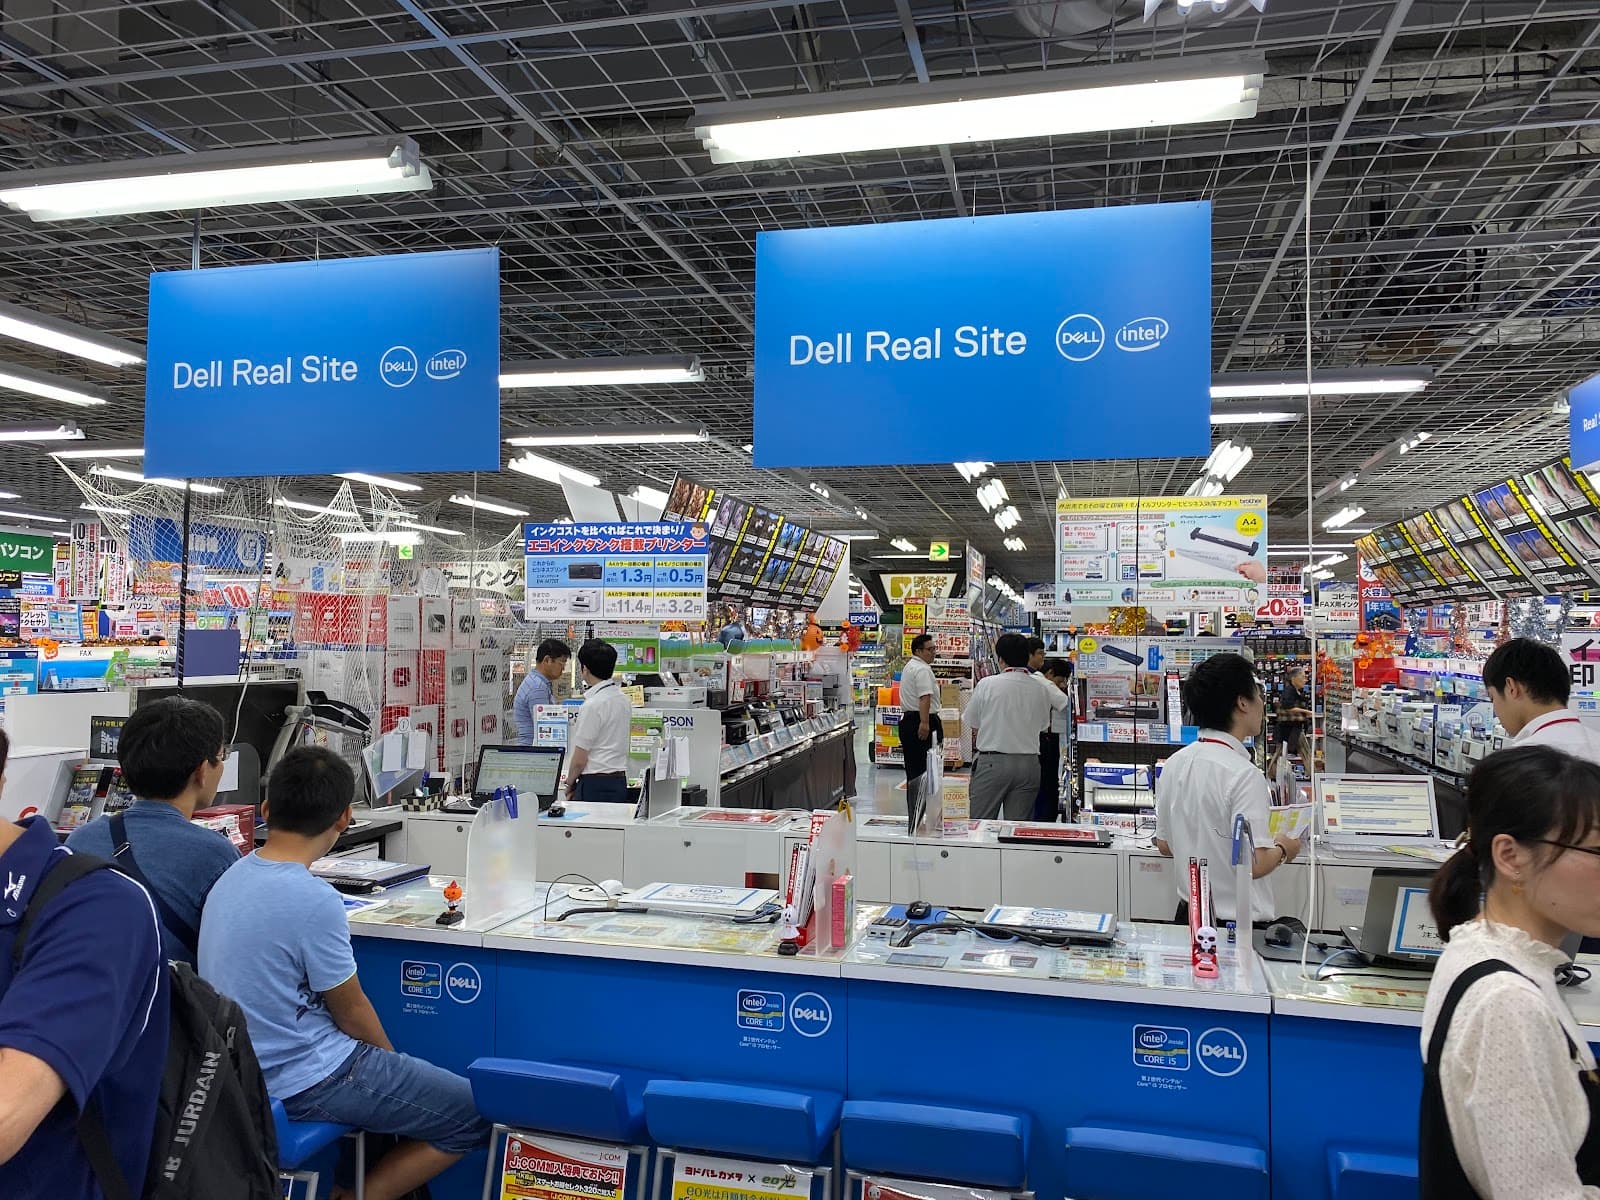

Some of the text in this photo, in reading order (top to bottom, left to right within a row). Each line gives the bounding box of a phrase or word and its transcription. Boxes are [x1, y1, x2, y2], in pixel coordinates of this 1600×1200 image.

[790, 324, 1027, 365] Dell Real Site
[174, 355, 358, 388] Dell Real Site
[1584, 413, 1598, 432] Real
[528, 538, 706, 552] エコインクタンク搭載プリンター
[620, 568, 652, 582] 1.3円
[670, 568, 702, 582] 0.5円
[1363, 588, 1390, 597] 大容量
[662, 716, 694, 726] PSON
[12, 875, 26, 901] MIZUNO
[408, 968, 422, 976] intel
[450, 976, 477, 989] DELL
[746, 998, 762, 1006] intel
[746, 1018, 763, 1026] CORE
[795, 1008, 827, 1022] DELL
[1144, 1034, 1163, 1043] intel
[1202, 1044, 1242, 1060] DELL
[1144, 1055, 1176, 1065] CORE i5
[174, 1051, 221, 1148] JURDAIN
[510, 1156, 620, 1184] J:COM加入特典でおトク!!
[685, 1166, 743, 1182] ヨドバシカメラ
[762, 1174, 796, 1190] eo光
